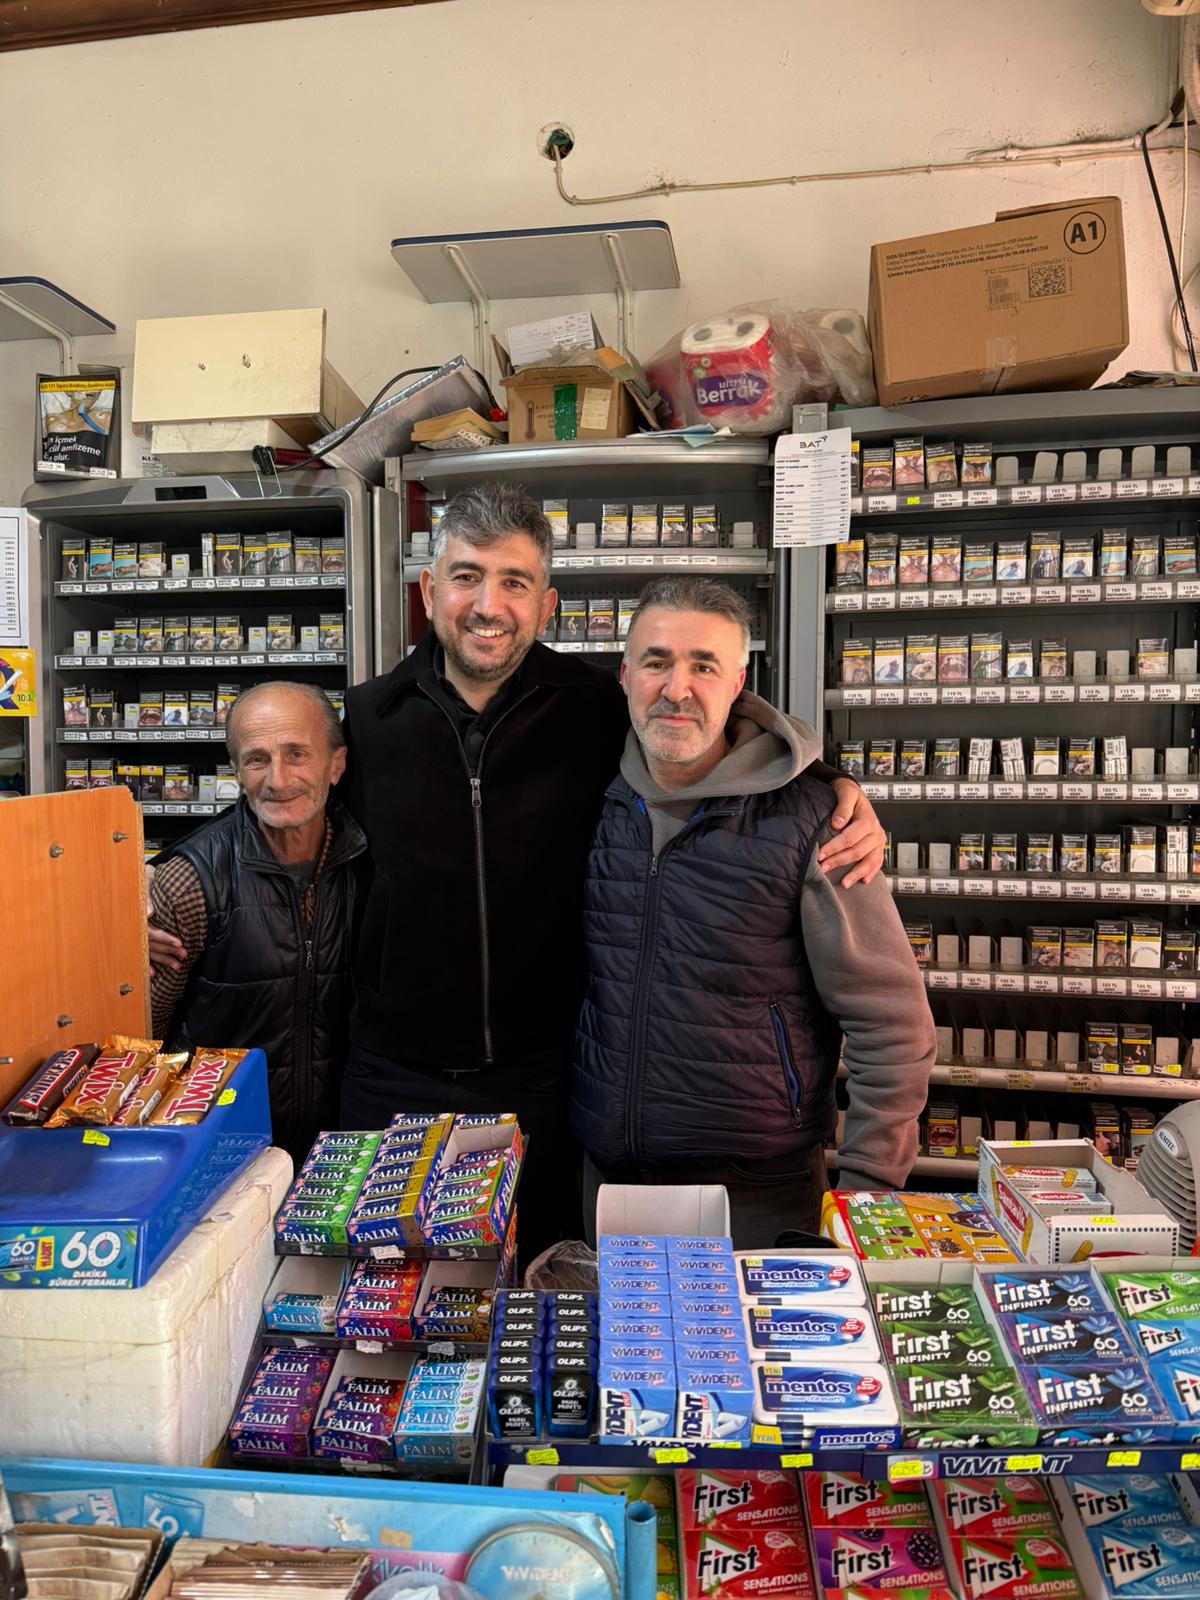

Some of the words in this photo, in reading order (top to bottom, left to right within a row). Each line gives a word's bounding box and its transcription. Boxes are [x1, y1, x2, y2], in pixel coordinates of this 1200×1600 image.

[1070, 221, 1098, 244] A1
[696, 380, 762, 404] Berrak
[800, 440, 820, 449] BAT
[25, 1050, 78, 1104] SNICKERS
[76, 1052, 138, 1106] TWIX
[165, 1059, 227, 1119] TWIX
[386, 1132, 424, 1144] FALIM
[380, 1149, 419, 1162] FALIM
[371, 1167, 410, 1180] FALIM
[443, 1168, 483, 1180] FALIM
[297, 1187, 337, 1196] FALIM
[365, 1183, 405, 1195] FALIM
[436, 1187, 475, 1200] FALIM
[356, 1204, 398, 1218] FALIM
[431, 1204, 472, 1218] FALIM
[283, 1232, 327, 1243] FALIM
[355, 1227, 400, 1242] FALIM
[431, 1229, 476, 1245] FALIM
[11, 1241, 35, 1256] 60
[61, 1231, 121, 1268] 60
[748, 1269, 824, 1280] mentos
[356, 1277, 397, 1288] FALIM
[435, 1292, 477, 1303] FALIM
[994, 1279, 1051, 1304] First
[1116, 1283, 1172, 1308] First
[348, 1300, 392, 1310] FALIM
[876, 1291, 932, 1313] First
[1000, 1298, 1052, 1312] INFINITY
[1067, 1296, 1091, 1307] 60
[273, 1313, 316, 1323] FALIM
[880, 1310, 932, 1322] INFINITY
[946, 1308, 970, 1320] 60
[345, 1326, 390, 1337] FALIM
[424, 1324, 469, 1333] FALIM
[756, 1320, 836, 1333] mentos
[1015, 1320, 1076, 1346] First
[892, 1330, 951, 1355] First
[1093, 1338, 1119, 1350] 60
[1138, 1328, 1184, 1347] First
[1022, 1341, 1078, 1355] INFINITY
[895, 1352, 951, 1365] INFINITY
[966, 1350, 992, 1362] 60
[265, 1361, 310, 1372] FALIM
[419, 1366, 462, 1376] FALIM
[255, 1385, 300, 1396] FALIM
[347, 1383, 391, 1394] FALIM
[766, 1379, 852, 1394] mentos
[908, 1374, 972, 1401] First
[1038, 1373, 1102, 1404] First
[411, 1389, 455, 1399] FALIM
[1121, 1393, 1148, 1408] 60
[337, 1400, 382, 1413] FALIM
[912, 1398, 972, 1412] INFINITY
[988, 1395, 1015, 1409] 60
[1045, 1396, 1104, 1415] INFINITY
[243, 1412, 288, 1424] FALIM
[405, 1412, 449, 1423] FALIM
[327, 1418, 373, 1433] FALIM
[237, 1439, 286, 1451] FALIM
[320, 1436, 369, 1452] FALIM
[820, 1432, 895, 1445] mentos
[403, 1444, 451, 1455] FALIM
[694, 1482, 752, 1512] First
[822, 1480, 878, 1509] First
[1073, 1489, 1128, 1514] First
[866, 1502, 927, 1518] SENSATIONS
[946, 1489, 1002, 1518] First
[736, 1505, 799, 1522] SENSATIONS
[991, 1512, 1053, 1528] SENSATIONS
[698, 1546, 759, 1579] First
[832, 1545, 892, 1578] First
[1102, 1545, 1162, 1576] First
[964, 1554, 1026, 1585] First
[743, 1573, 809, 1592] SENSATIONS
[880, 1570, 945, 1588] SENSATIONS
[1012, 1579, 1077, 1598] SENSATIONS
